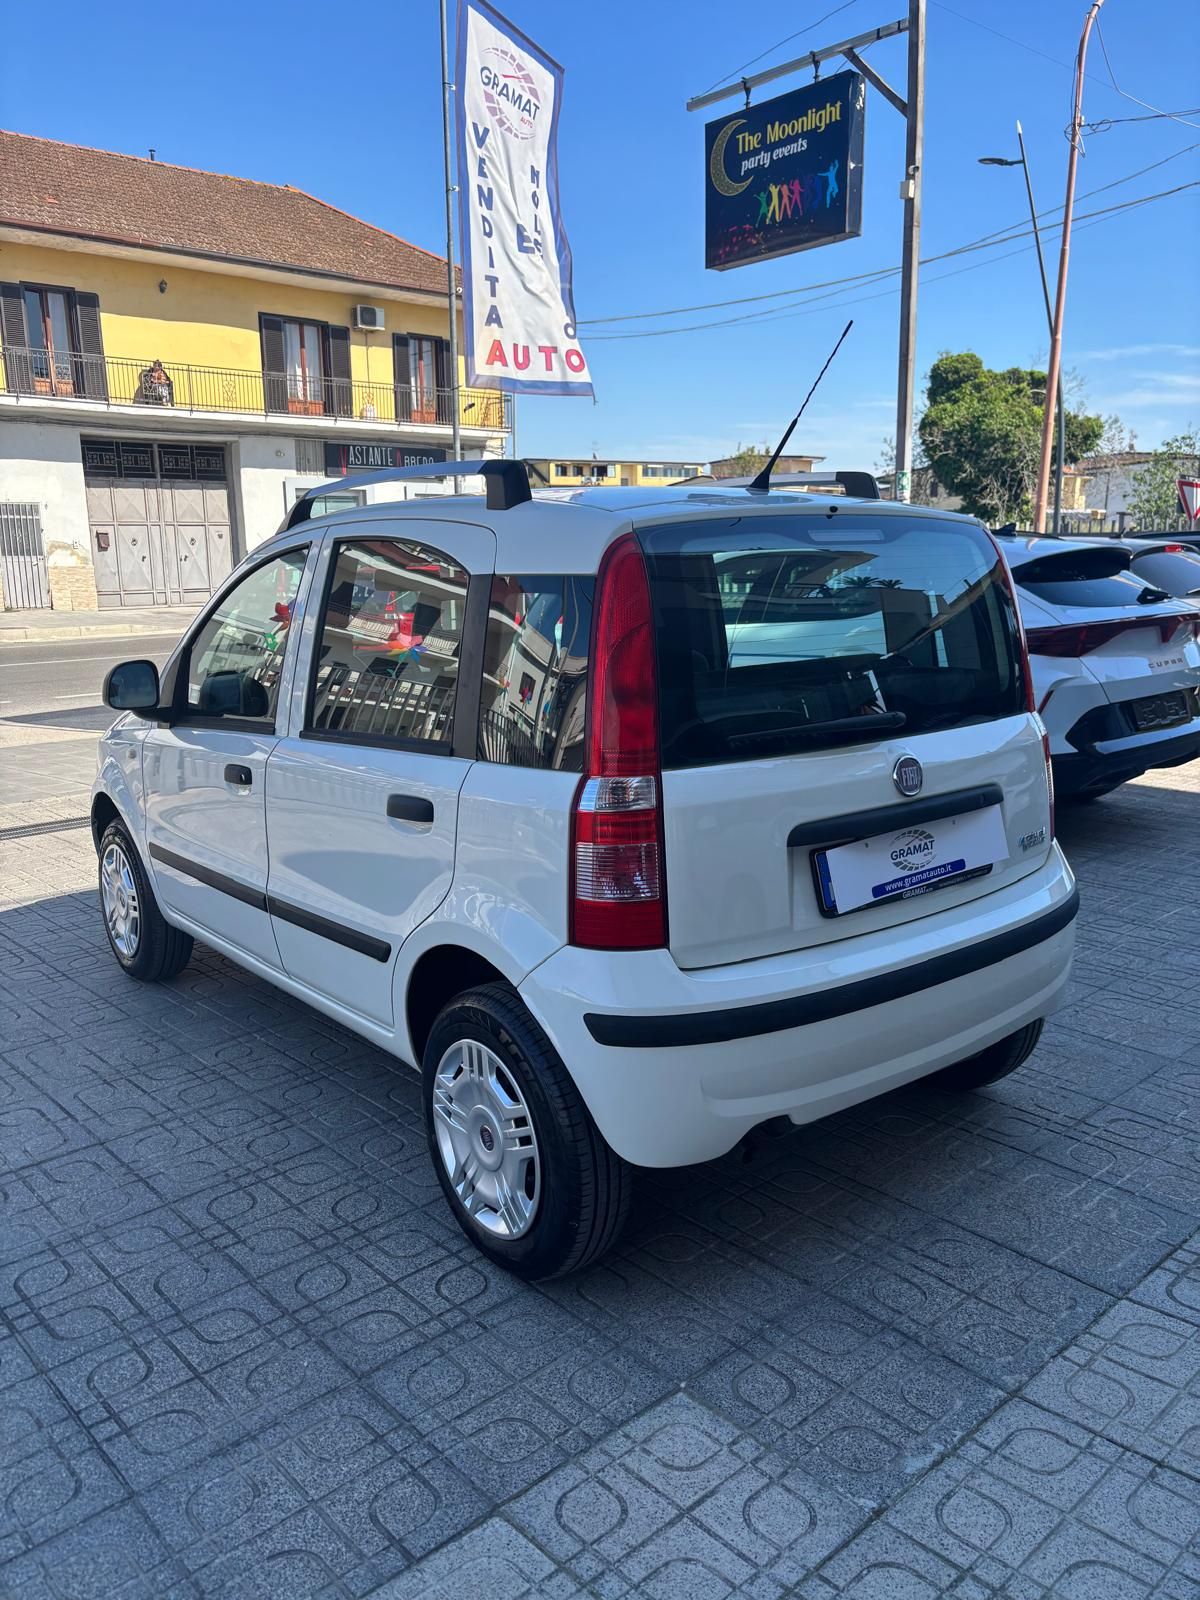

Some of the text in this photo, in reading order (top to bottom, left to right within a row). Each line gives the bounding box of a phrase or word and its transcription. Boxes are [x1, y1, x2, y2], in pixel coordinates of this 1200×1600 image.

[480, 66, 540, 120] GRAMAT
[736, 101, 843, 155] The Moonlight
[740, 138, 808, 176] party events
[472, 121, 503, 329] VENDITA
[485, 339, 586, 373] AUTO
[339, 445, 394, 475] VASTANTE
[890, 839, 935, 861] GRAMAT
[884, 864, 952, 892] www.gramatauto.it
[902, 886, 927, 899] GRAMAT
